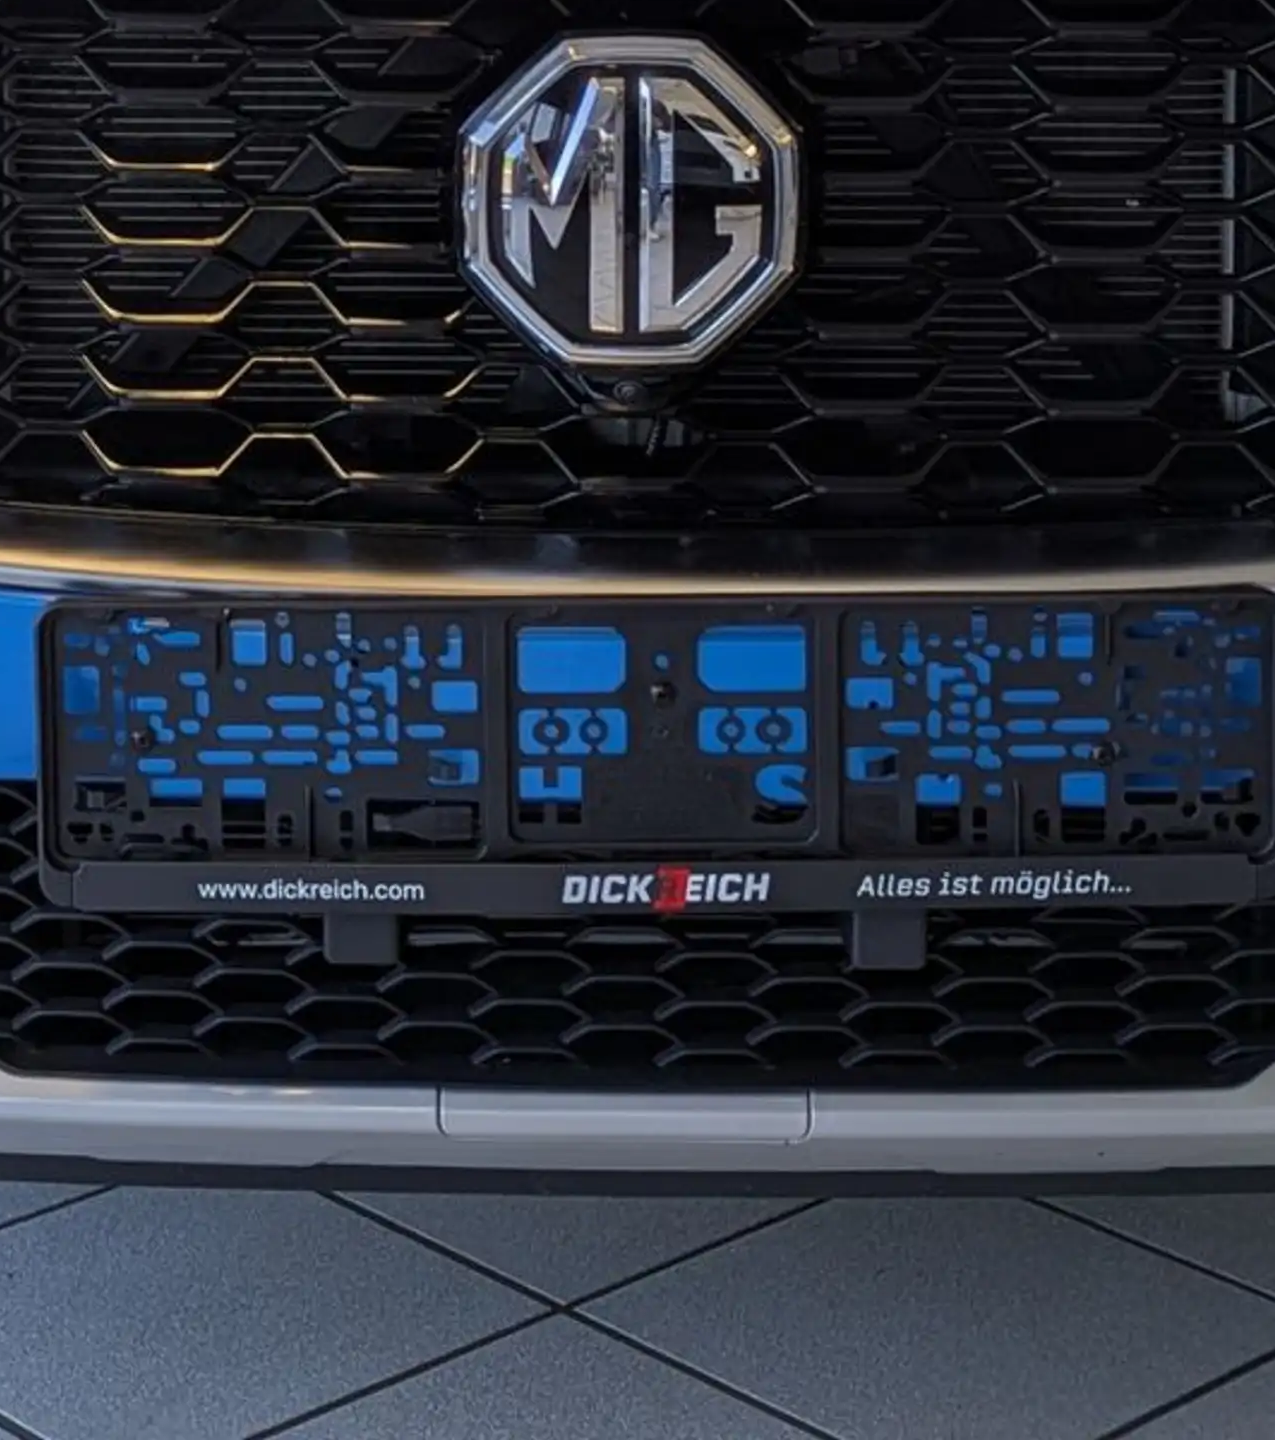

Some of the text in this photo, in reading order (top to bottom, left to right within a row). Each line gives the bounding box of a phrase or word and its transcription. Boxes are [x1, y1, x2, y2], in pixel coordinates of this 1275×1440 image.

[503, 76, 763, 334] MG
[196, 877, 426, 901] www.dickreich.com
[855, 869, 1133, 900] Alles ist möglich...
